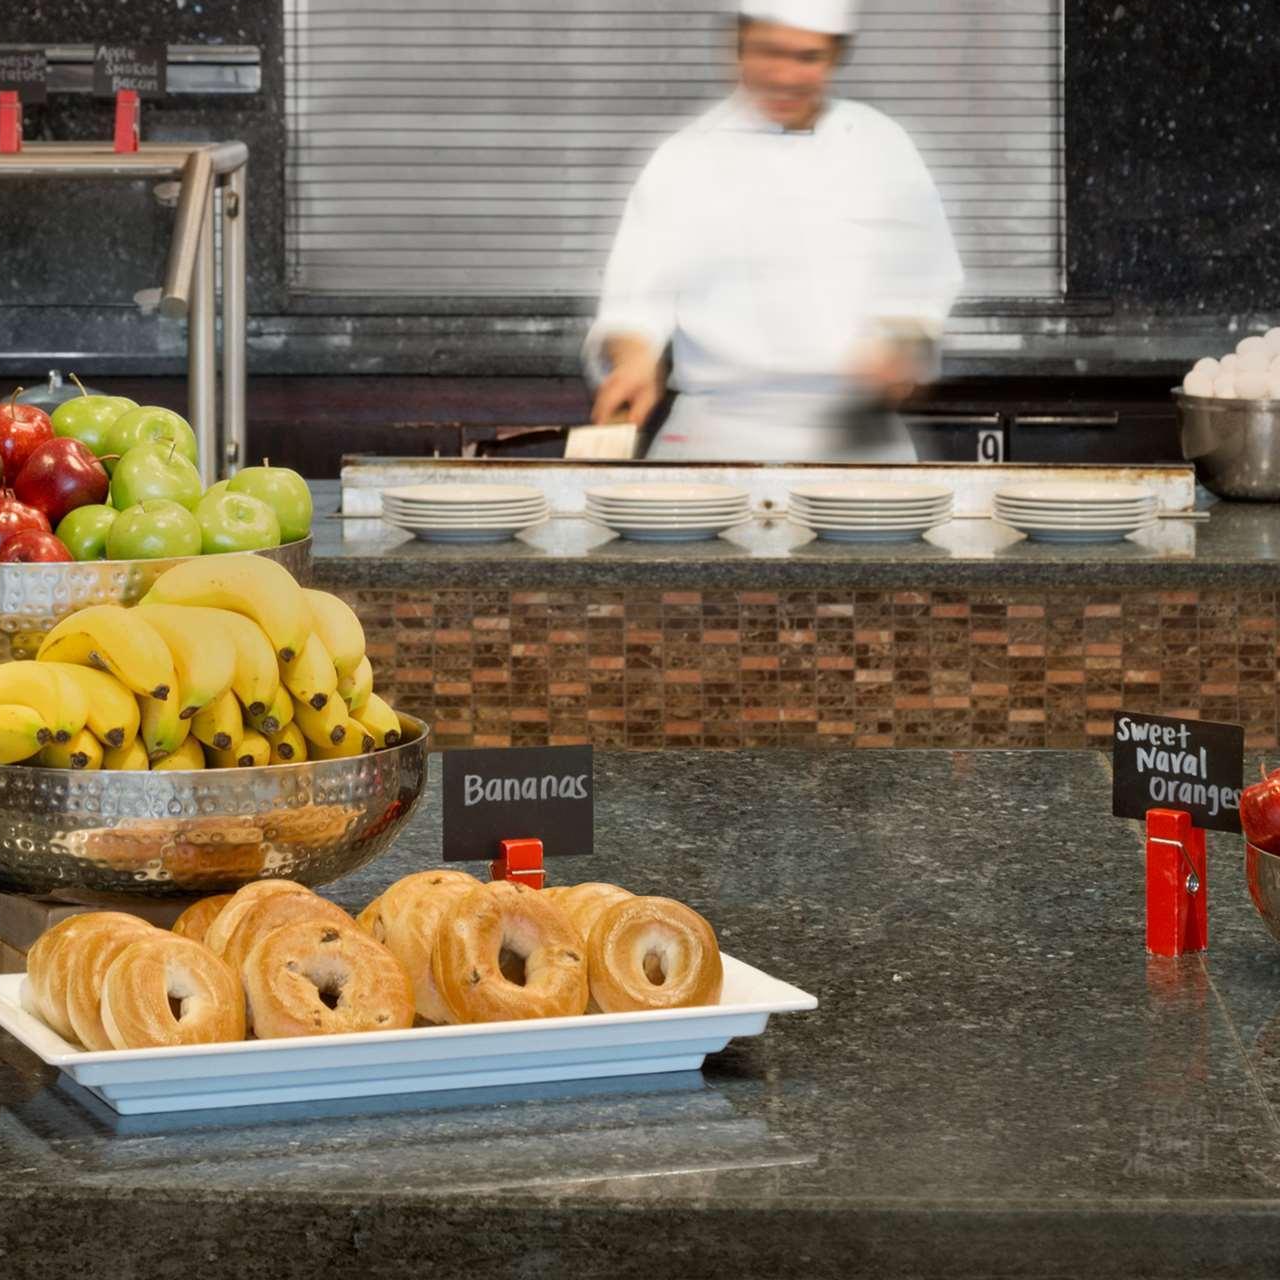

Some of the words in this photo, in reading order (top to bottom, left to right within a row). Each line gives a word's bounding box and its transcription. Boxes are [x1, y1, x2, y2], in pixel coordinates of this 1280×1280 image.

[1116, 717, 1191, 748] Sweet
[1136, 746, 1207, 780] Naval
[464, 774, 588, 807] Bananas
